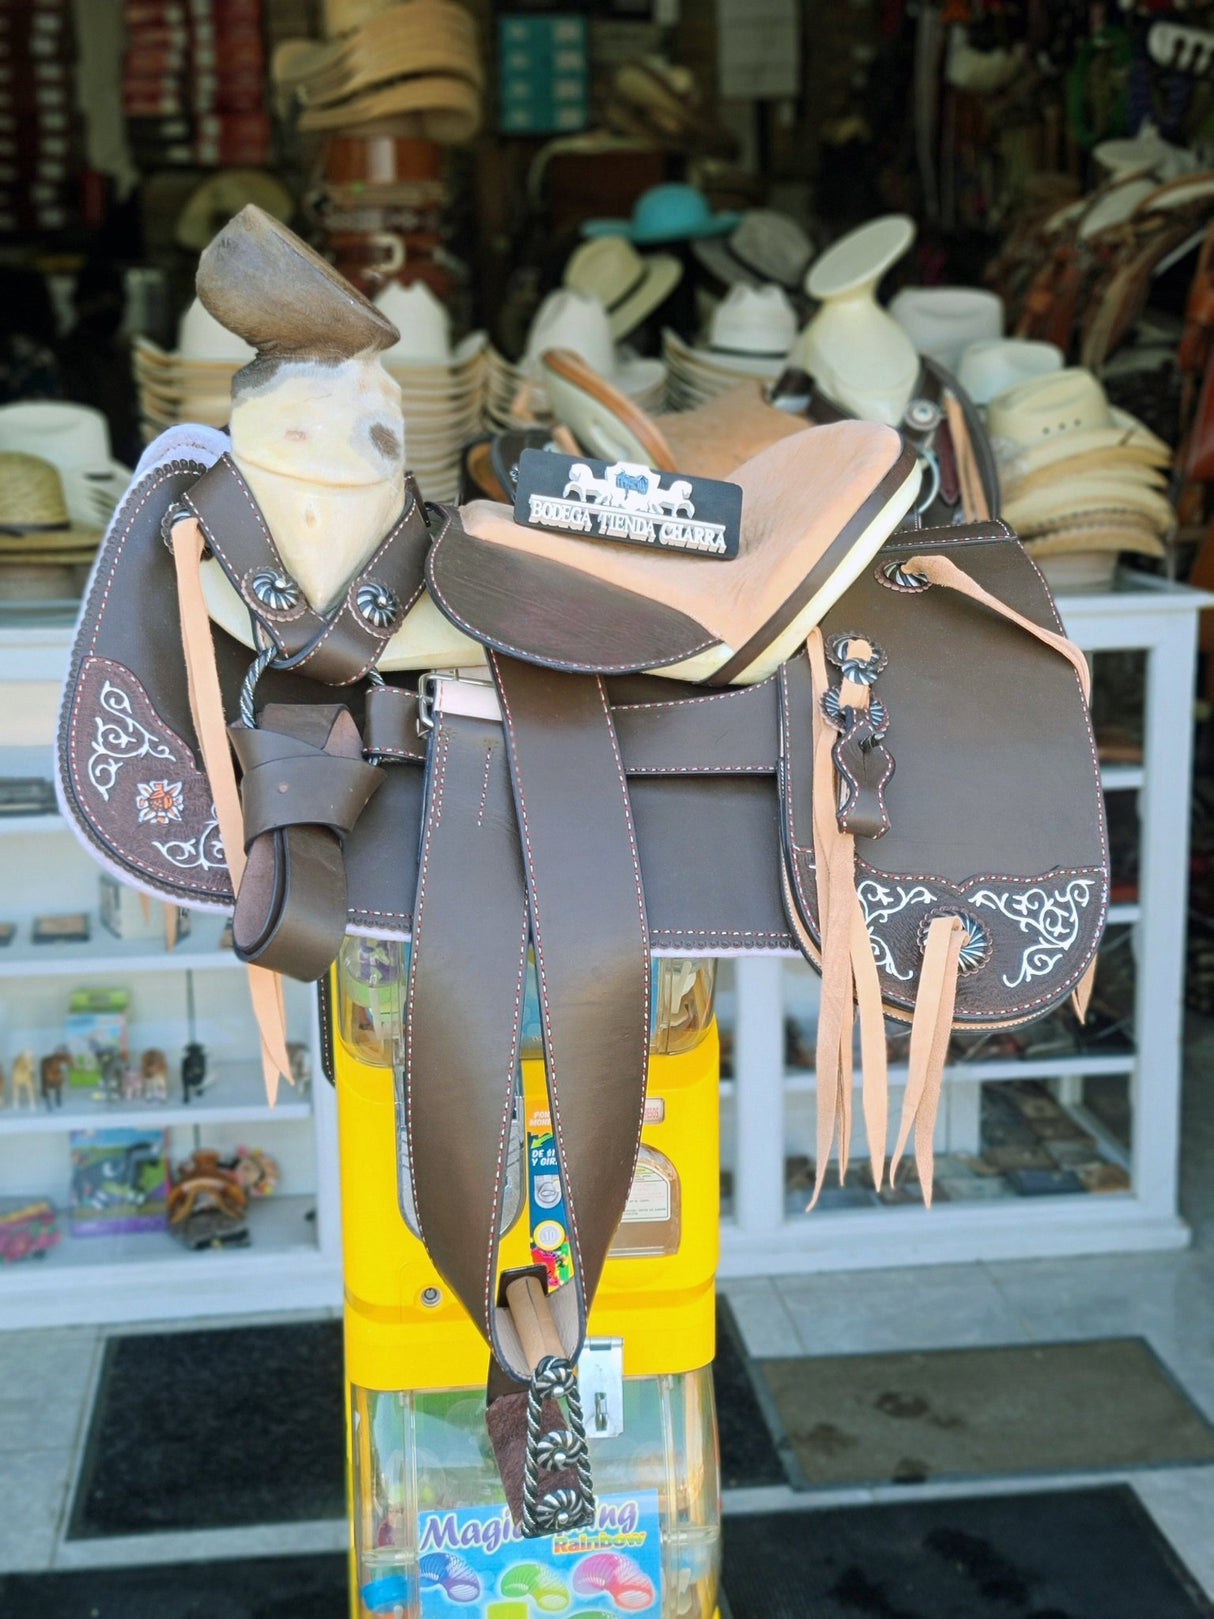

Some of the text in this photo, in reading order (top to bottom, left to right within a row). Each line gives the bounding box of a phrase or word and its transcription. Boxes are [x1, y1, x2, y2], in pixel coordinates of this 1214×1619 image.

[529, 500, 727, 553] BODEGA TIENDA CHARRA
[531, 1150, 544, 1158] DE
[531, 1158, 539, 1166] Y
[553, 1532, 646, 1554] Rainbow
